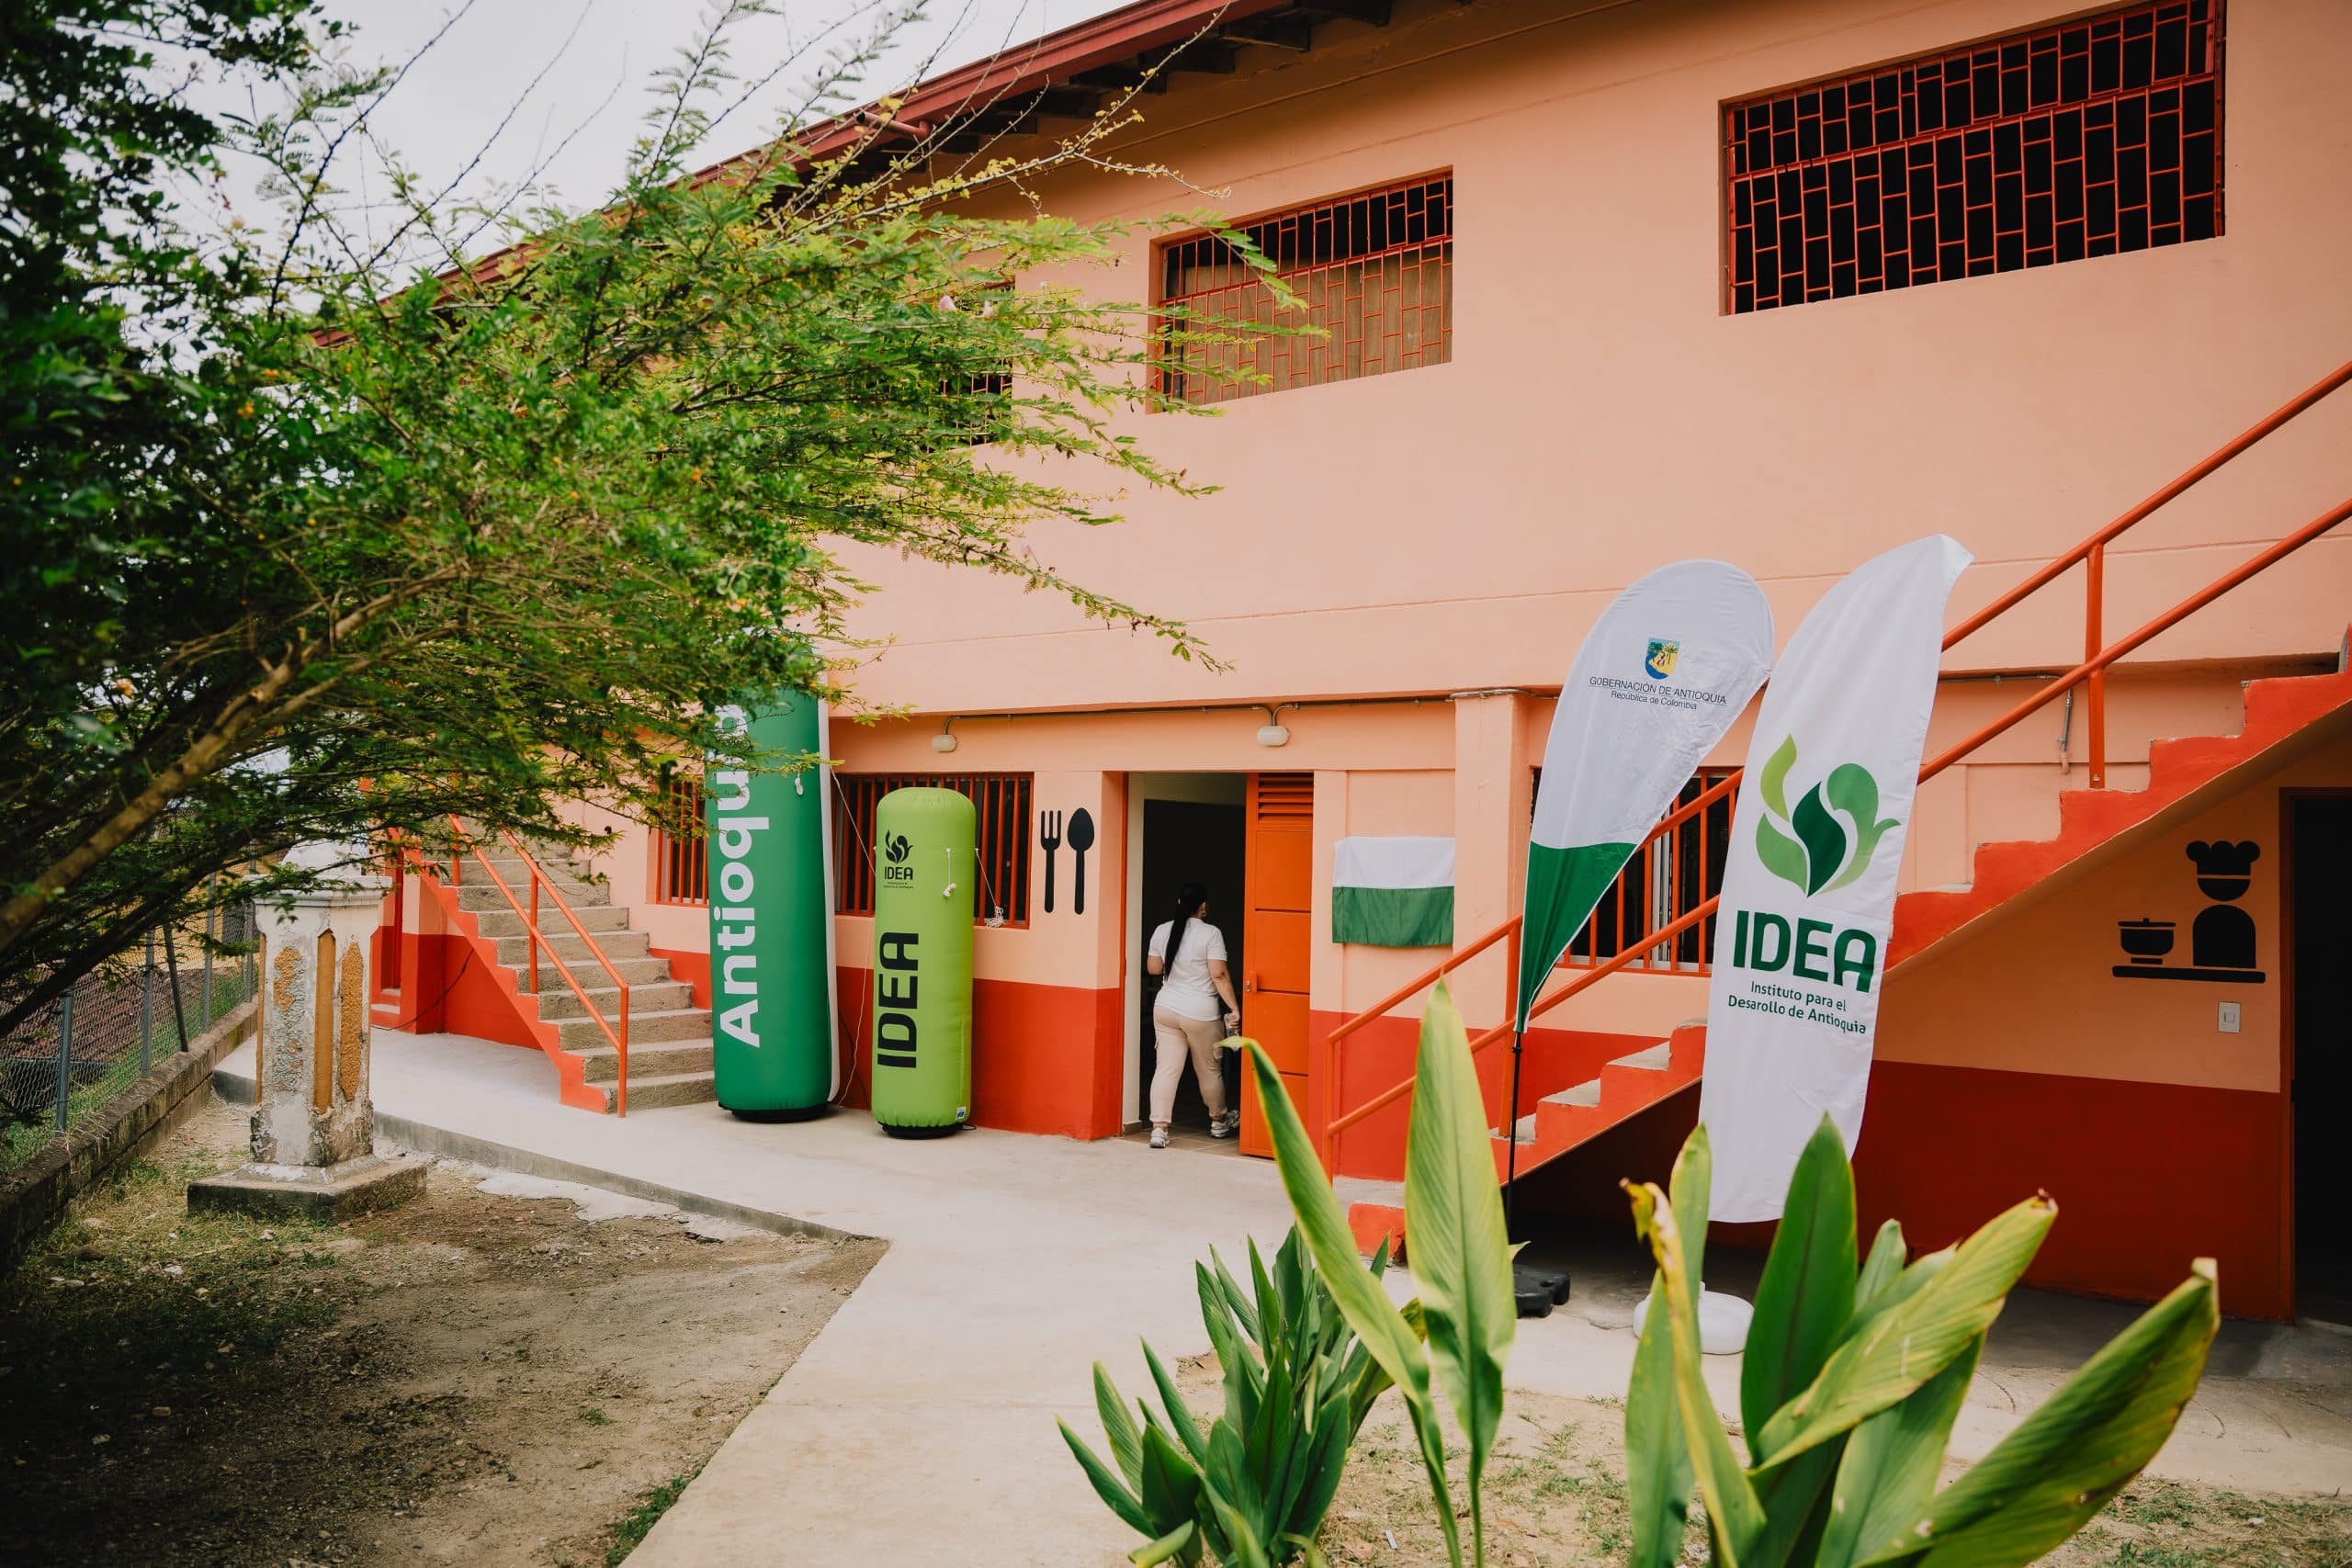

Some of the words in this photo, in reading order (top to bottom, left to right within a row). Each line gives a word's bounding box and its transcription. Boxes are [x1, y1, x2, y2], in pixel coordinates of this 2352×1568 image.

[1589, 676, 1656, 693] GOBERNACIÓN
[1658, 685, 1672, 695] DE
[1674, 688, 1726, 704] ANTIOQUIA
[1611, 690, 1647, 703] República
[1649, 696, 1659, 705] de
[1660, 697, 1697, 710] Colombia
[885, 866, 913, 880] IDEA
[1733, 910, 1876, 993] IDEA
[877, 931, 919, 1068] IDEA
[1751, 981, 1802, 1000] Instituto
[1805, 992, 1833, 1007] para
[1836, 998, 1847, 1011] el
[1728, 995, 1785, 1014] Desarollo
[1788, 1005, 1804, 1019] de
[1807, 1008, 1866, 1033] Antioquia
